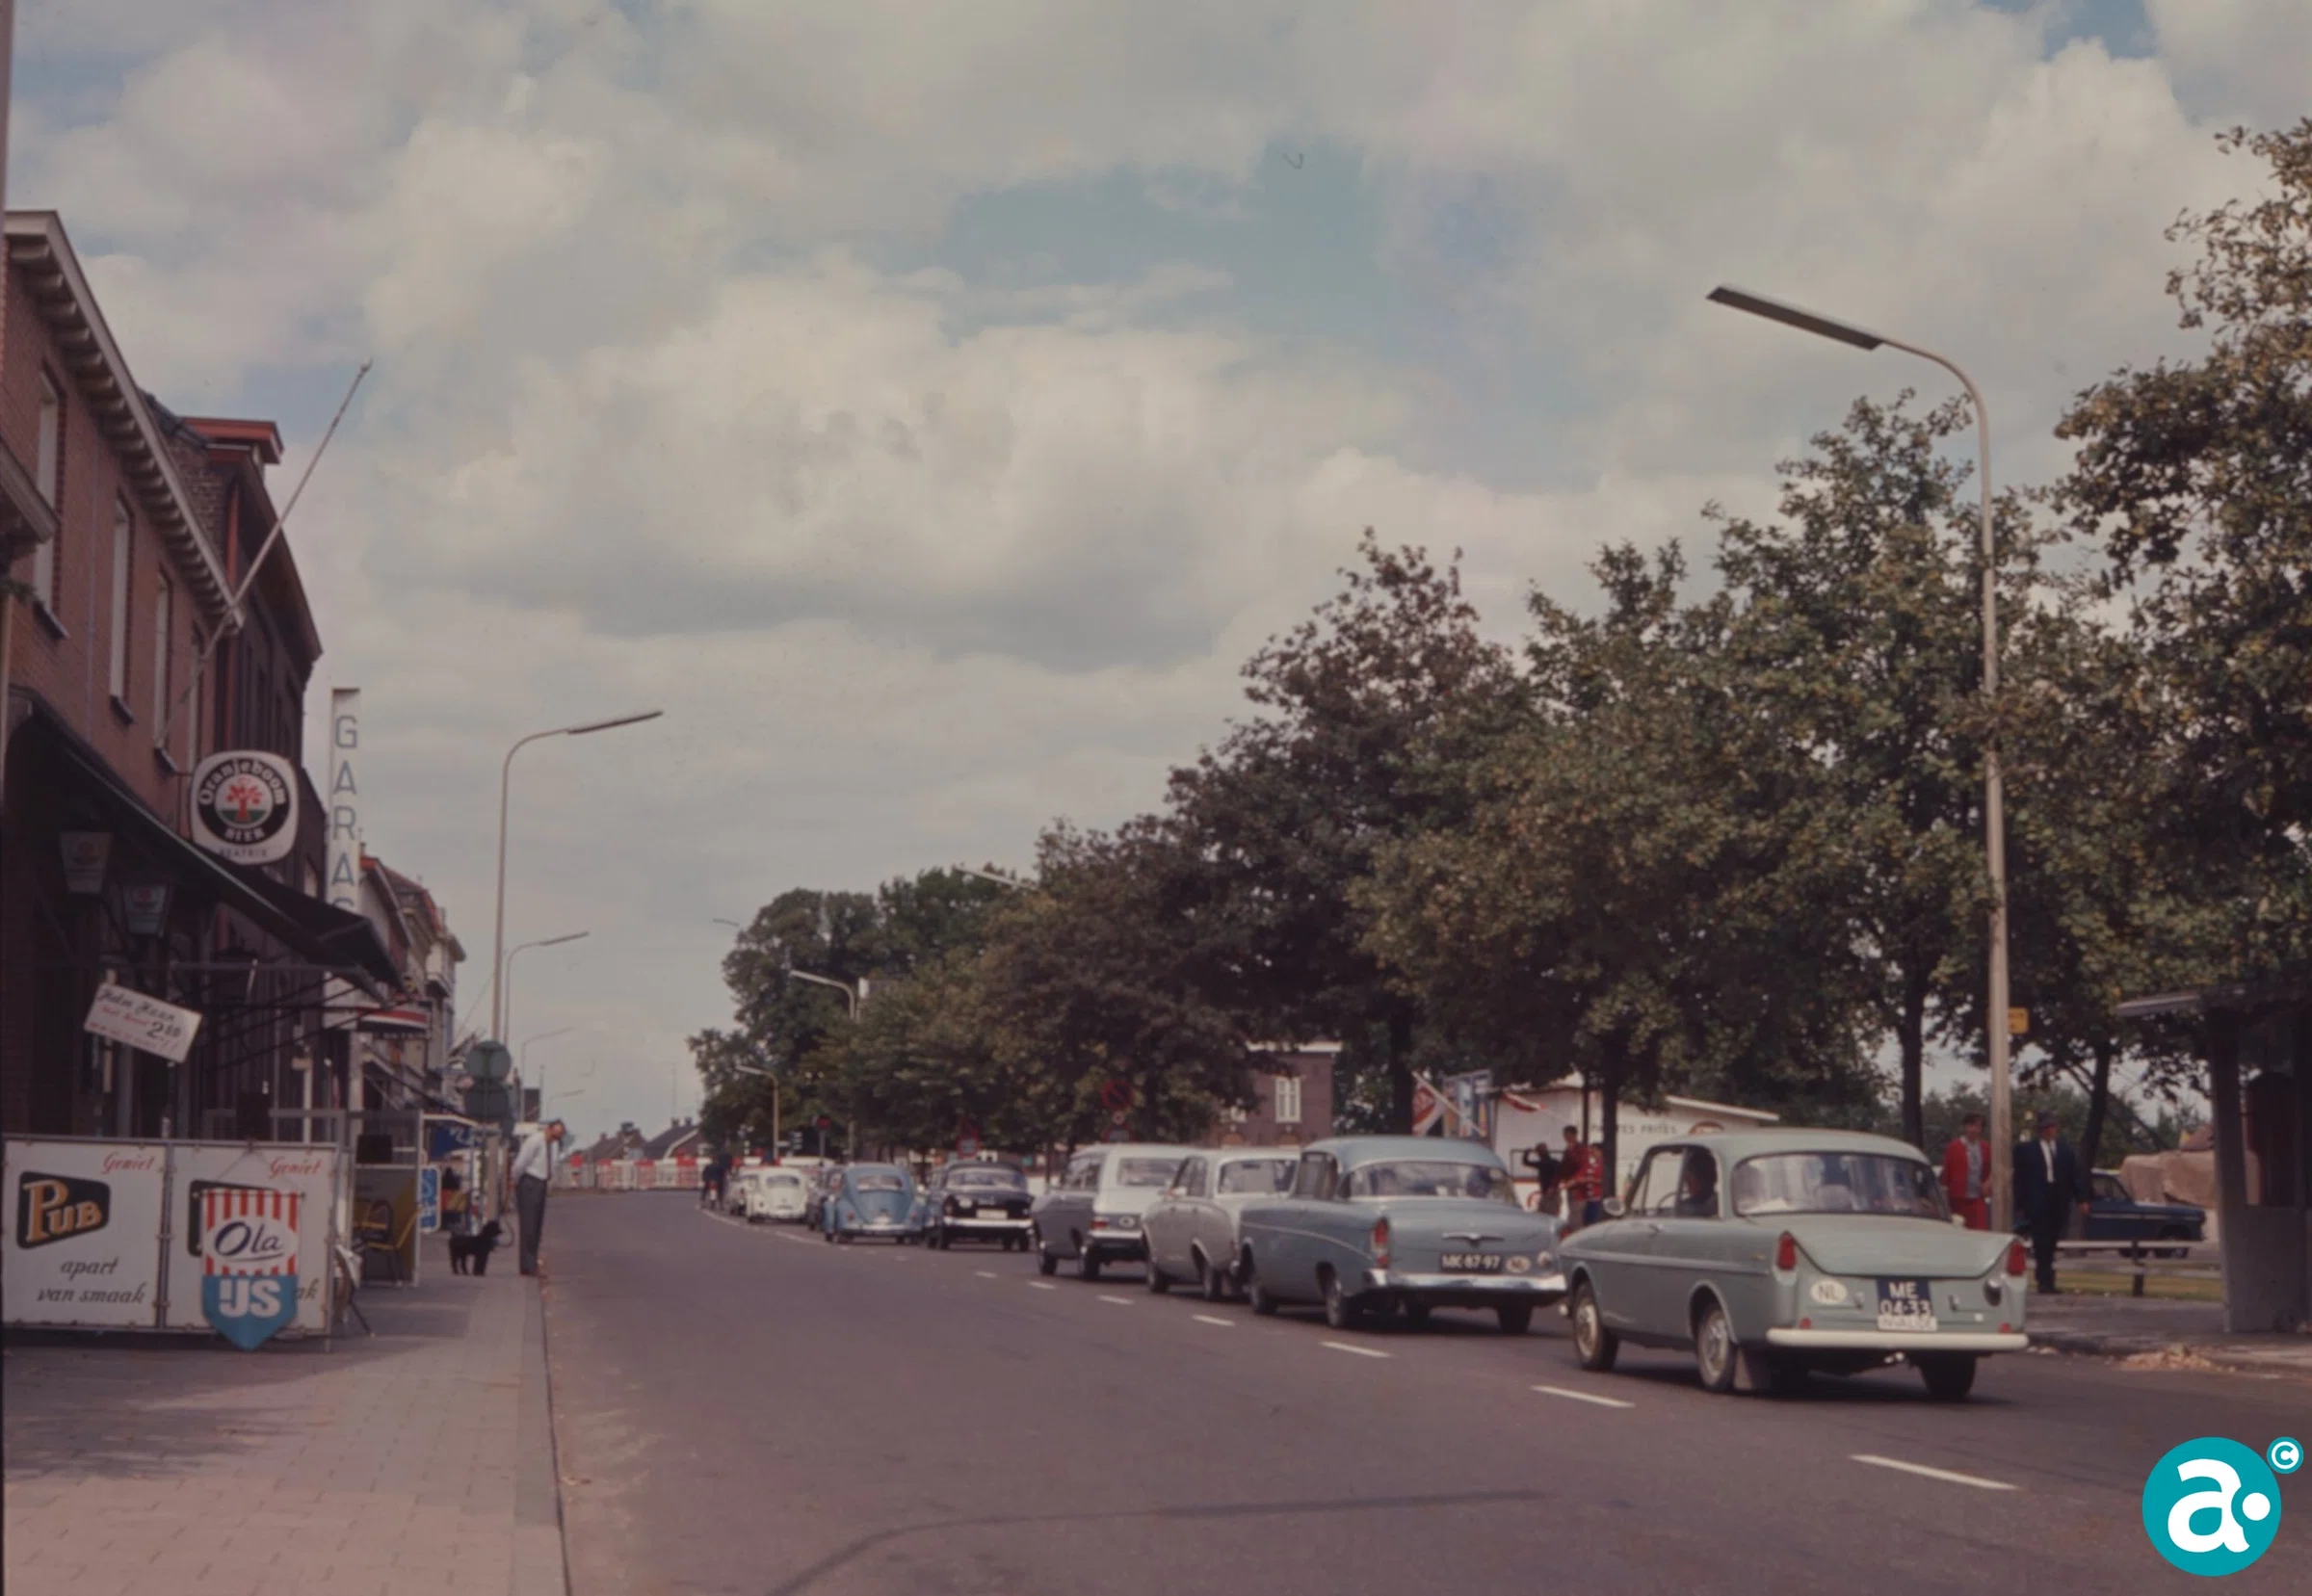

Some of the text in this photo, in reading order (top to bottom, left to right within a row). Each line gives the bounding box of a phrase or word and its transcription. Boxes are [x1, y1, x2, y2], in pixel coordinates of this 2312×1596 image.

[198, 759, 287, 806] Oranjeboom
[224, 826, 265, 842] BIER
[101, 1150, 155, 1175] Geniet
[269, 1158, 321, 1180] Geniet
[214, 1221, 282, 1256] Ola
[60, 1256, 118, 1282] apart
[37, 1281, 148, 1304] van smaak
[219, 1278, 282, 1319] IJS
[1818, 1285, 1839, 1300] NL
[1888, 1281, 1919, 1299] ME
[1879, 1299, 1931, 1317] 04-33
